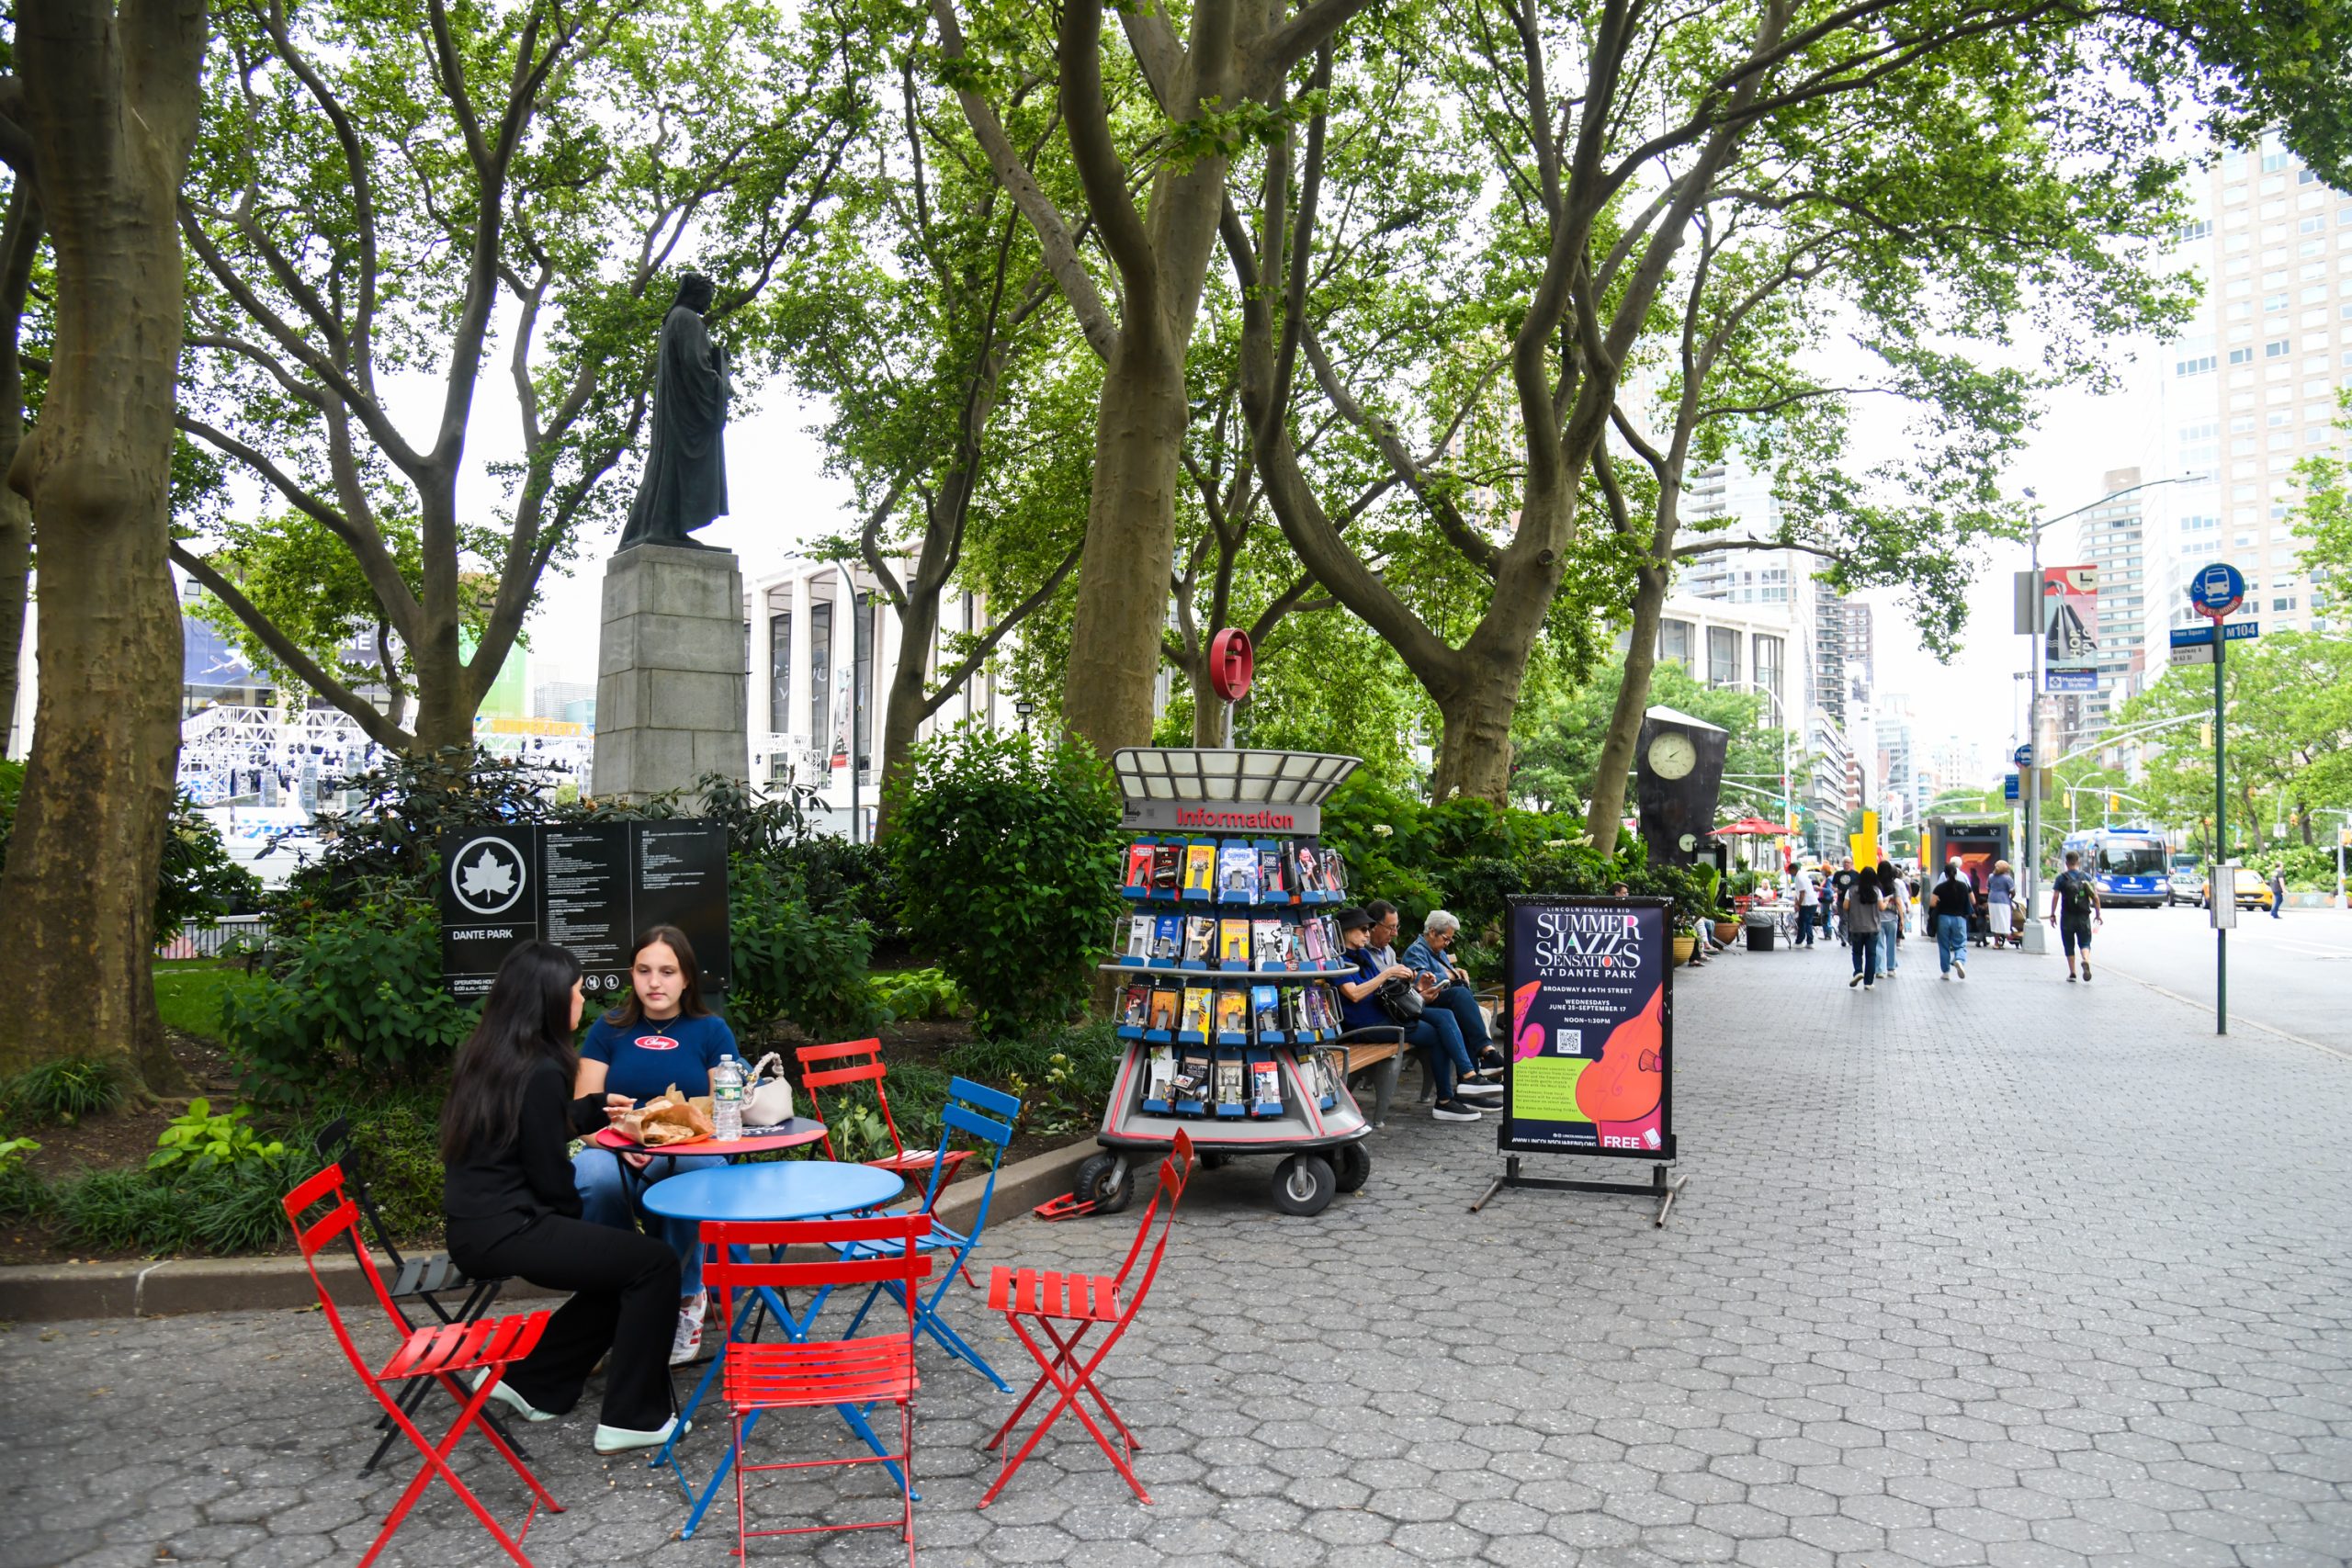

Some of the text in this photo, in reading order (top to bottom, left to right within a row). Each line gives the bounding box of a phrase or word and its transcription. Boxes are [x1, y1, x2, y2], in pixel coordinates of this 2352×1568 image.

[2226, 625, 2256, 637] M104
[1176, 807, 1295, 829] Information
[453, 929, 514, 940] DANTE PARK
[1536, 913, 1644, 941] SUMMER
[1552, 932, 1623, 955] JAZZ
[1534, 941, 1641, 969] SENSATIONS
[1540, 968, 1637, 978] AT DANTE PARK
[1603, 1135, 1640, 1148] FREE
